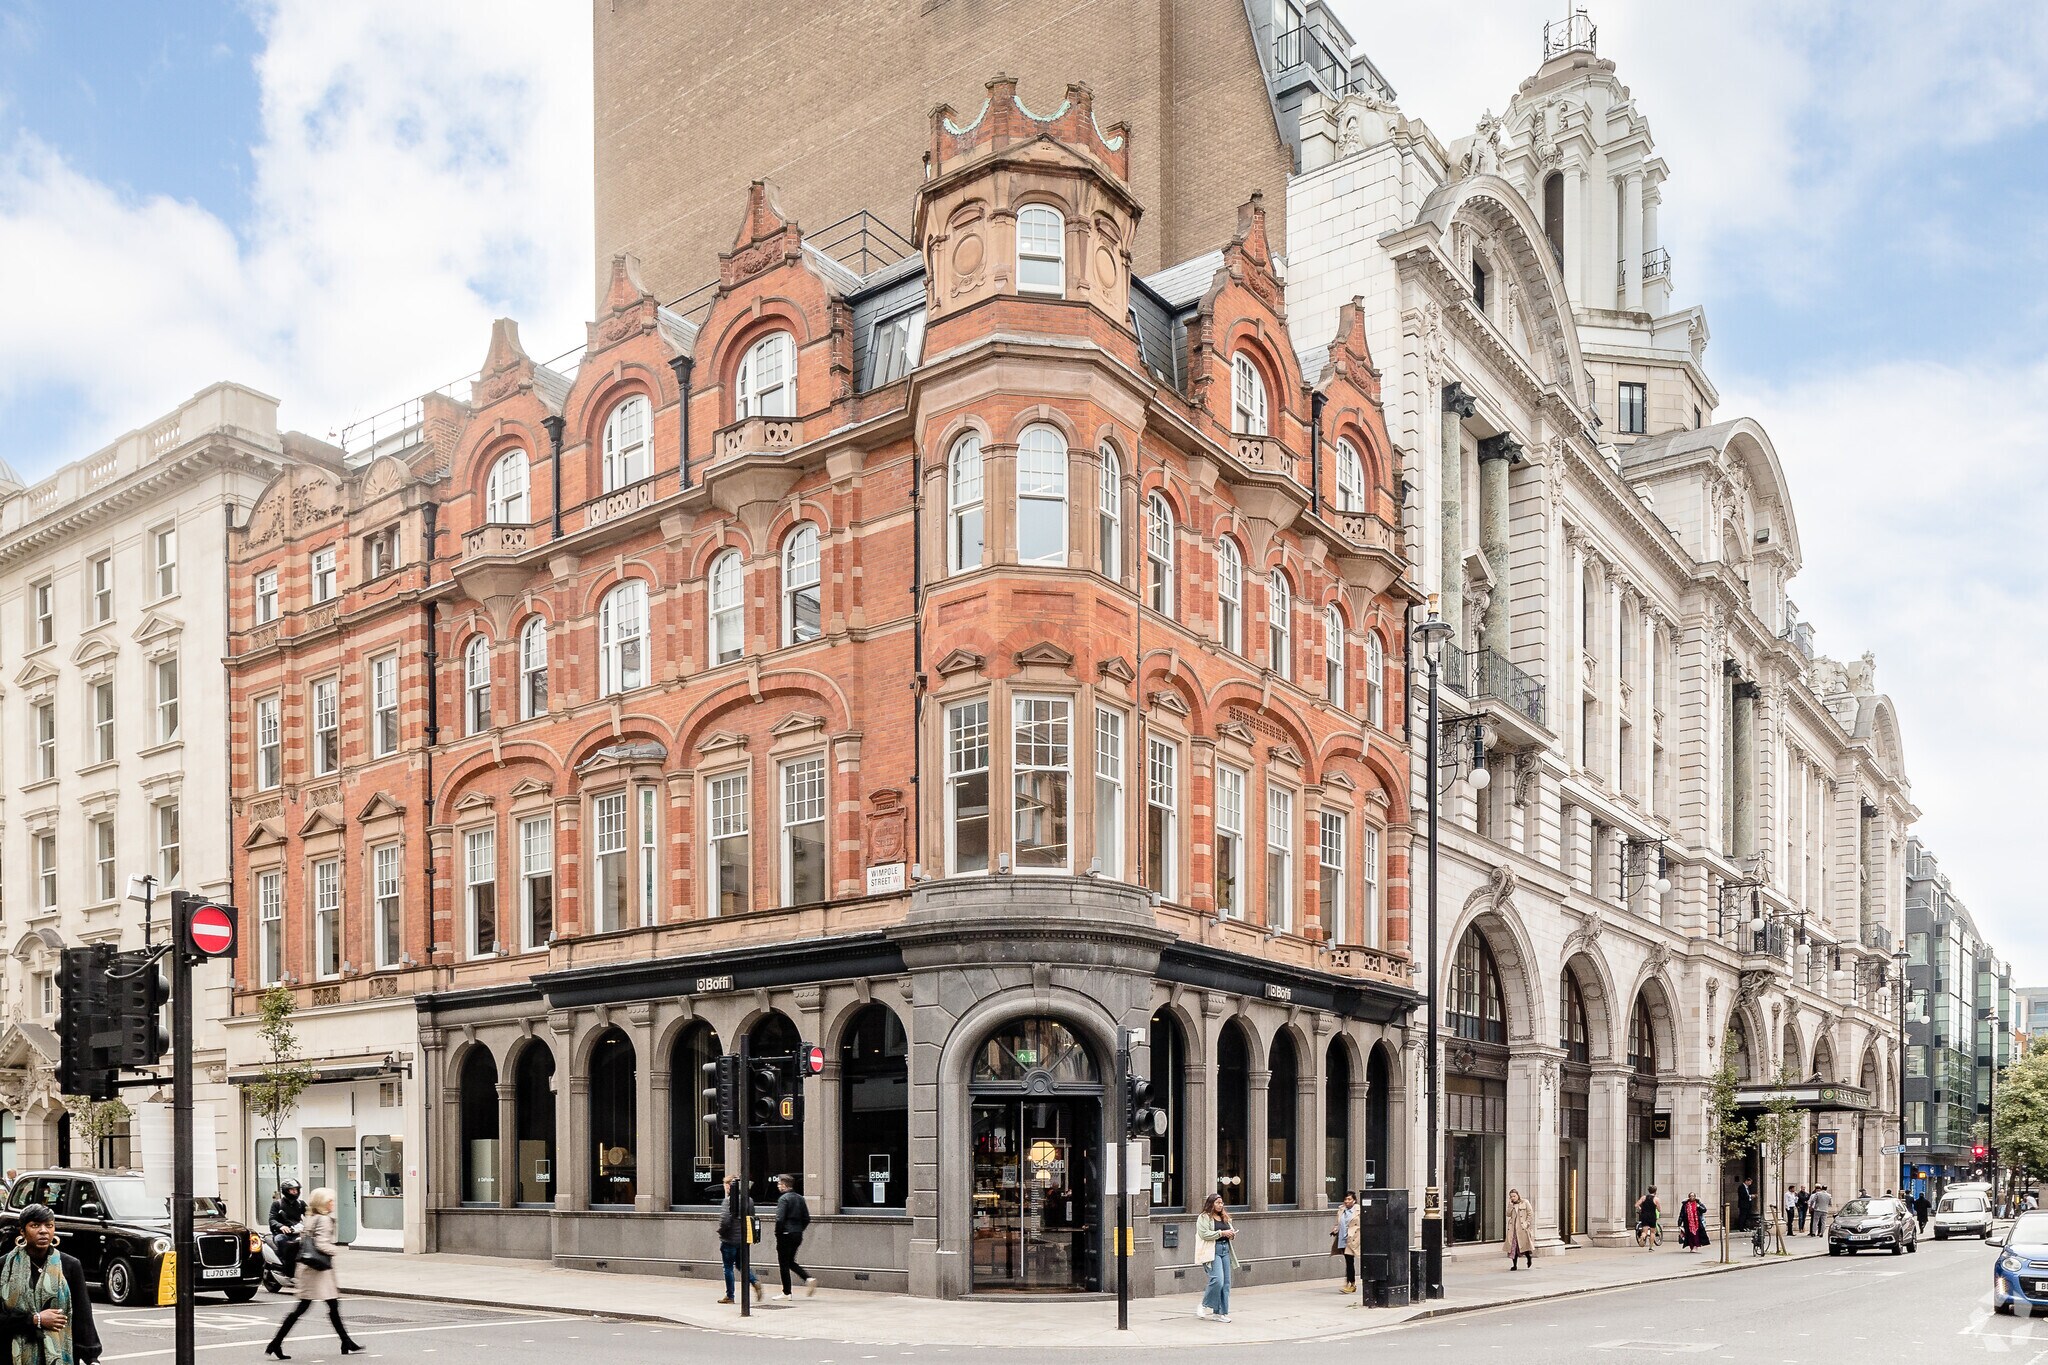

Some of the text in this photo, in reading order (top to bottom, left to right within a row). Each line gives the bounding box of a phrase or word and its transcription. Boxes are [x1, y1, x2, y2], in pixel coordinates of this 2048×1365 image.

[870, 866, 898, 878] WIMPOLE
[870, 875, 901, 887] STREET W1
[705, 976, 729, 990] Boffi
[1276, 986, 1291, 1000] Boffi
[875, 1171, 889, 1179] Boffi
[205, 1269, 238, 1278] LJ70 YSR
